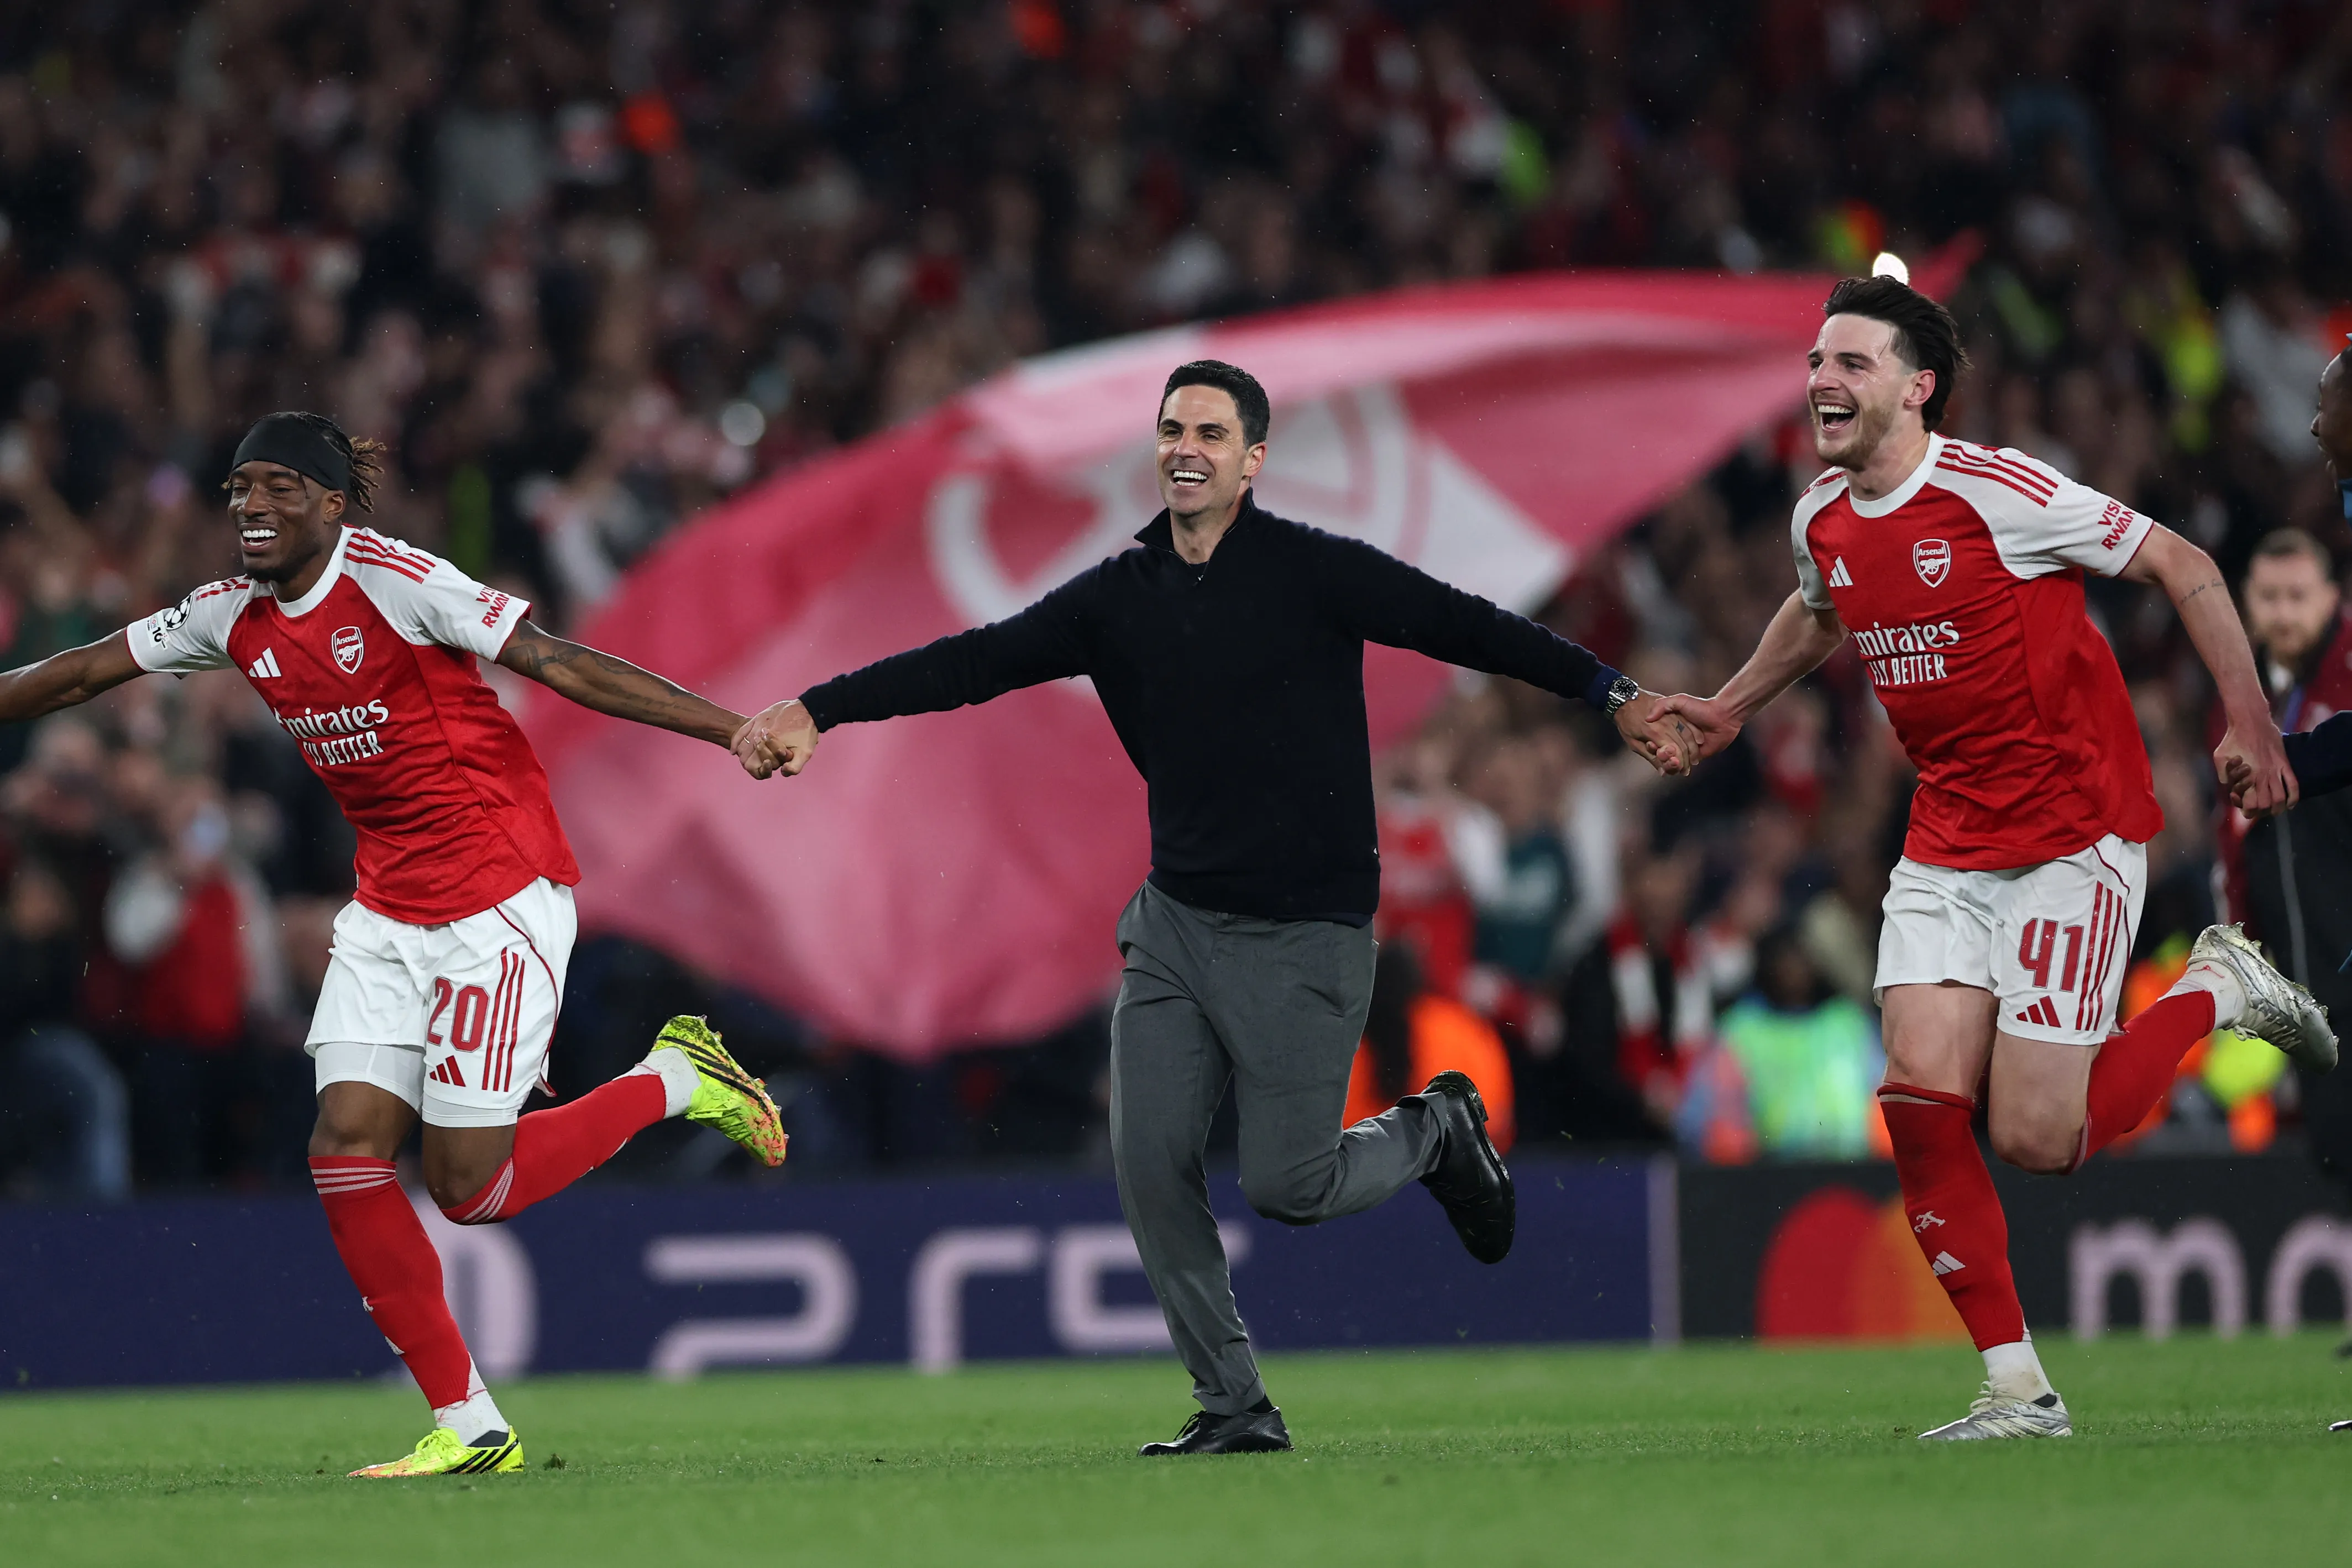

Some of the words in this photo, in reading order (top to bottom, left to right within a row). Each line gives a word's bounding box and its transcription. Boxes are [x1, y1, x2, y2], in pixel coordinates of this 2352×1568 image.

[1918, 547, 1945, 556] Arsenal
[337, 633, 358, 646] Arsenal
[1850, 621, 1960, 655] mirates
[1891, 653, 1948, 685] BETTER
[321, 731, 384, 766] BETTER
[2019, 917, 2084, 993] 41
[427, 976, 490, 1053] 20
